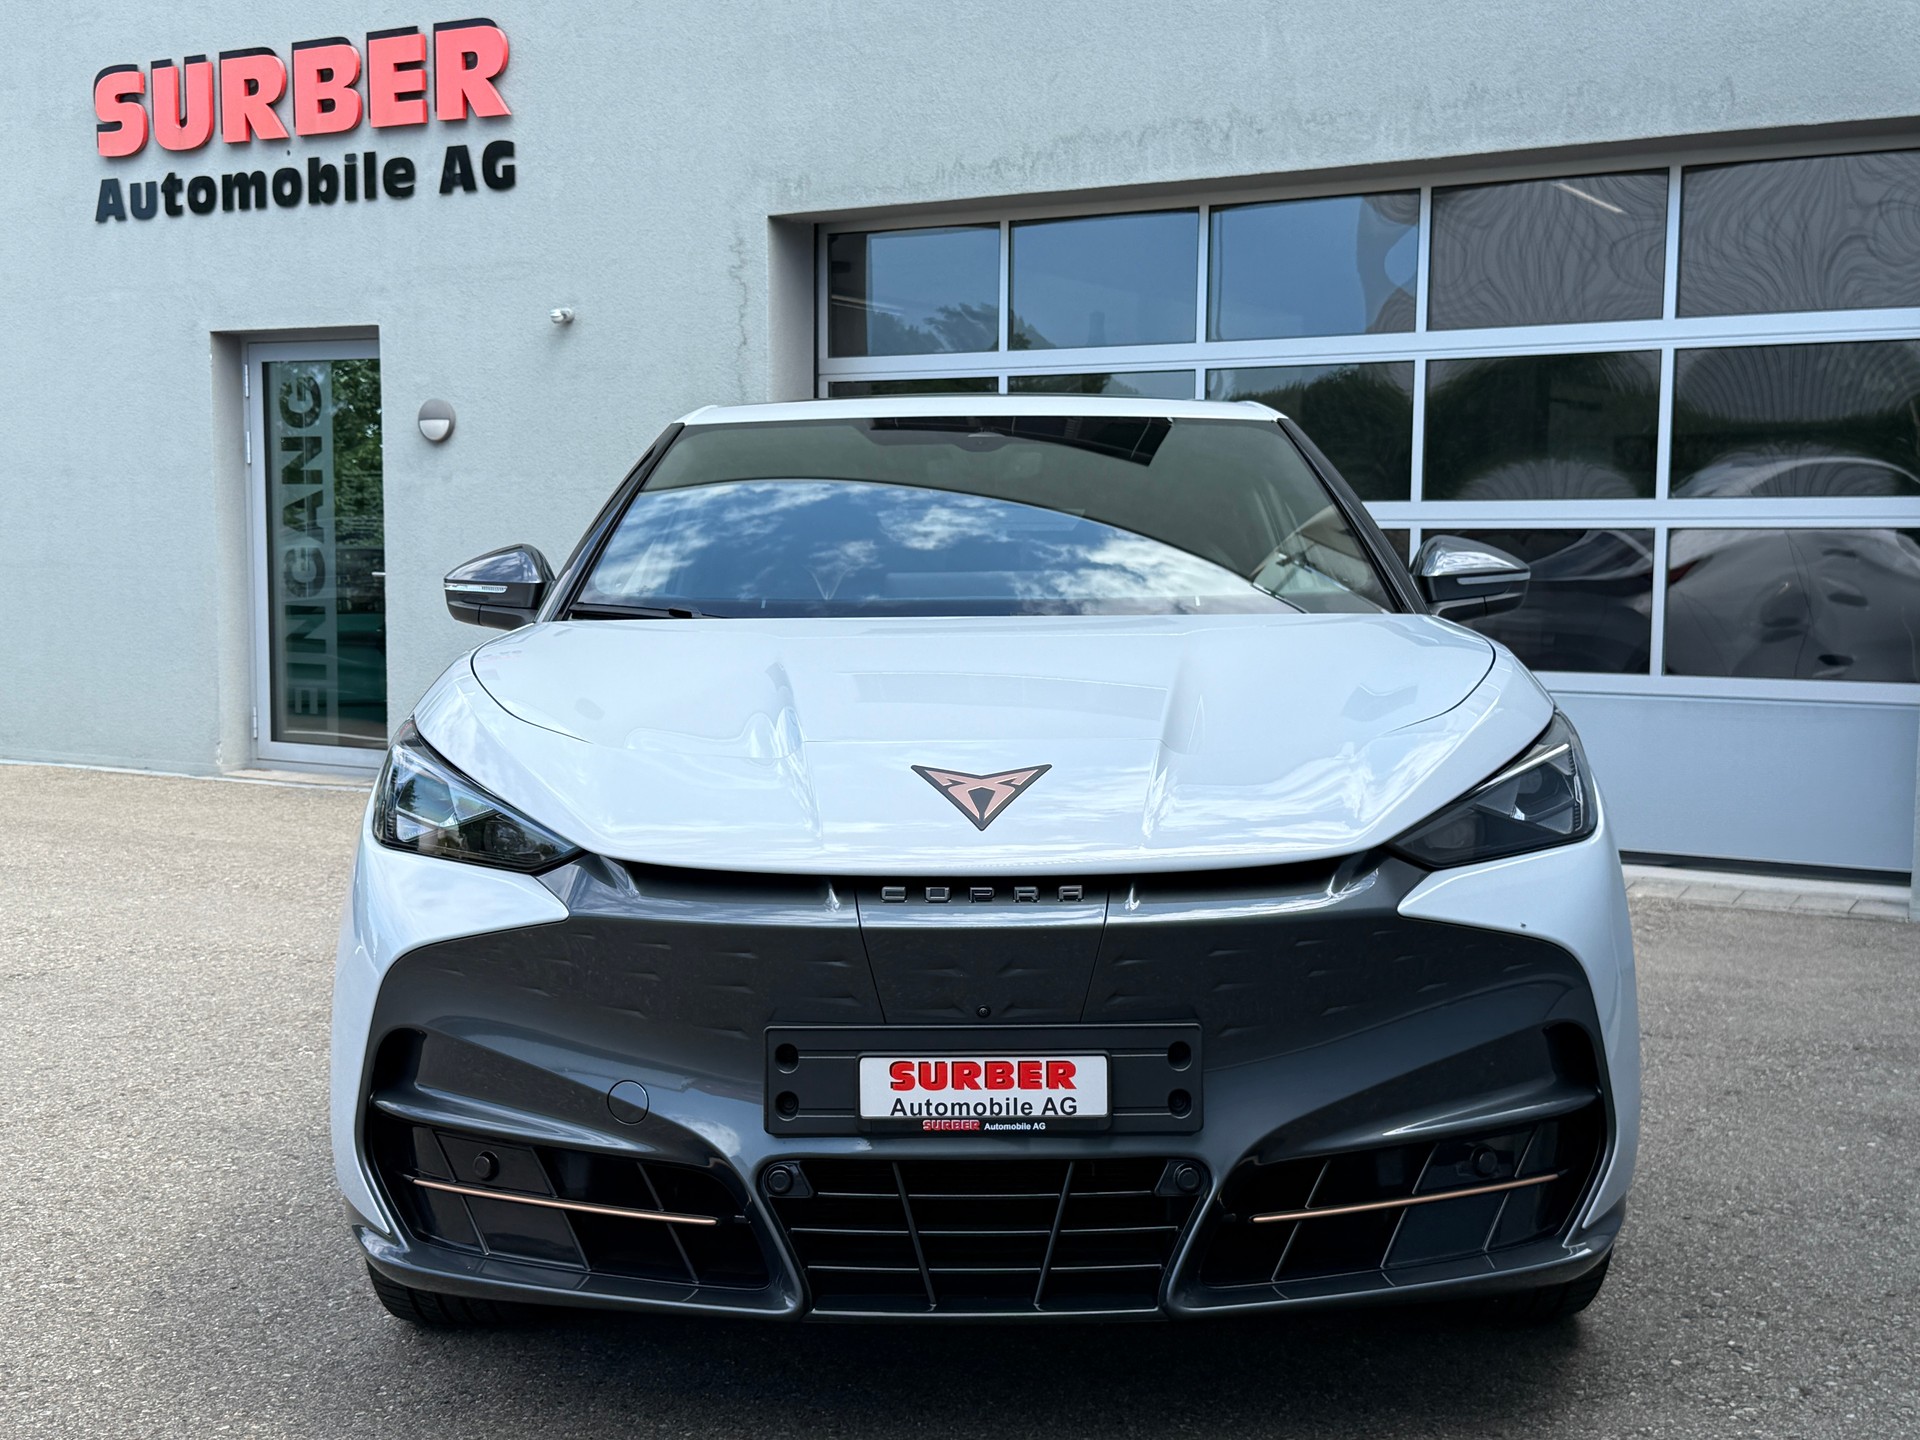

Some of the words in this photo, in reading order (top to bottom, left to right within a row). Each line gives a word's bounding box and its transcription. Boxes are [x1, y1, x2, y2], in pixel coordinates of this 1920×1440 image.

[93, 17, 511, 157] SURBER
[95, 151, 416, 223] Automobile
[440, 140, 516, 194] AG
[278, 375, 328, 730] EINGANG
[881, 885, 1085, 903] CUPRA
[889, 1060, 1077, 1091] SURBER
[890, 1098, 1033, 1117] Automobile
[1041, 1097, 1077, 1116] AG
[922, 1119, 980, 1131] SURBER
[984, 1122, 1031, 1131] Automobile
[1033, 1122, 1046, 1131] AG
